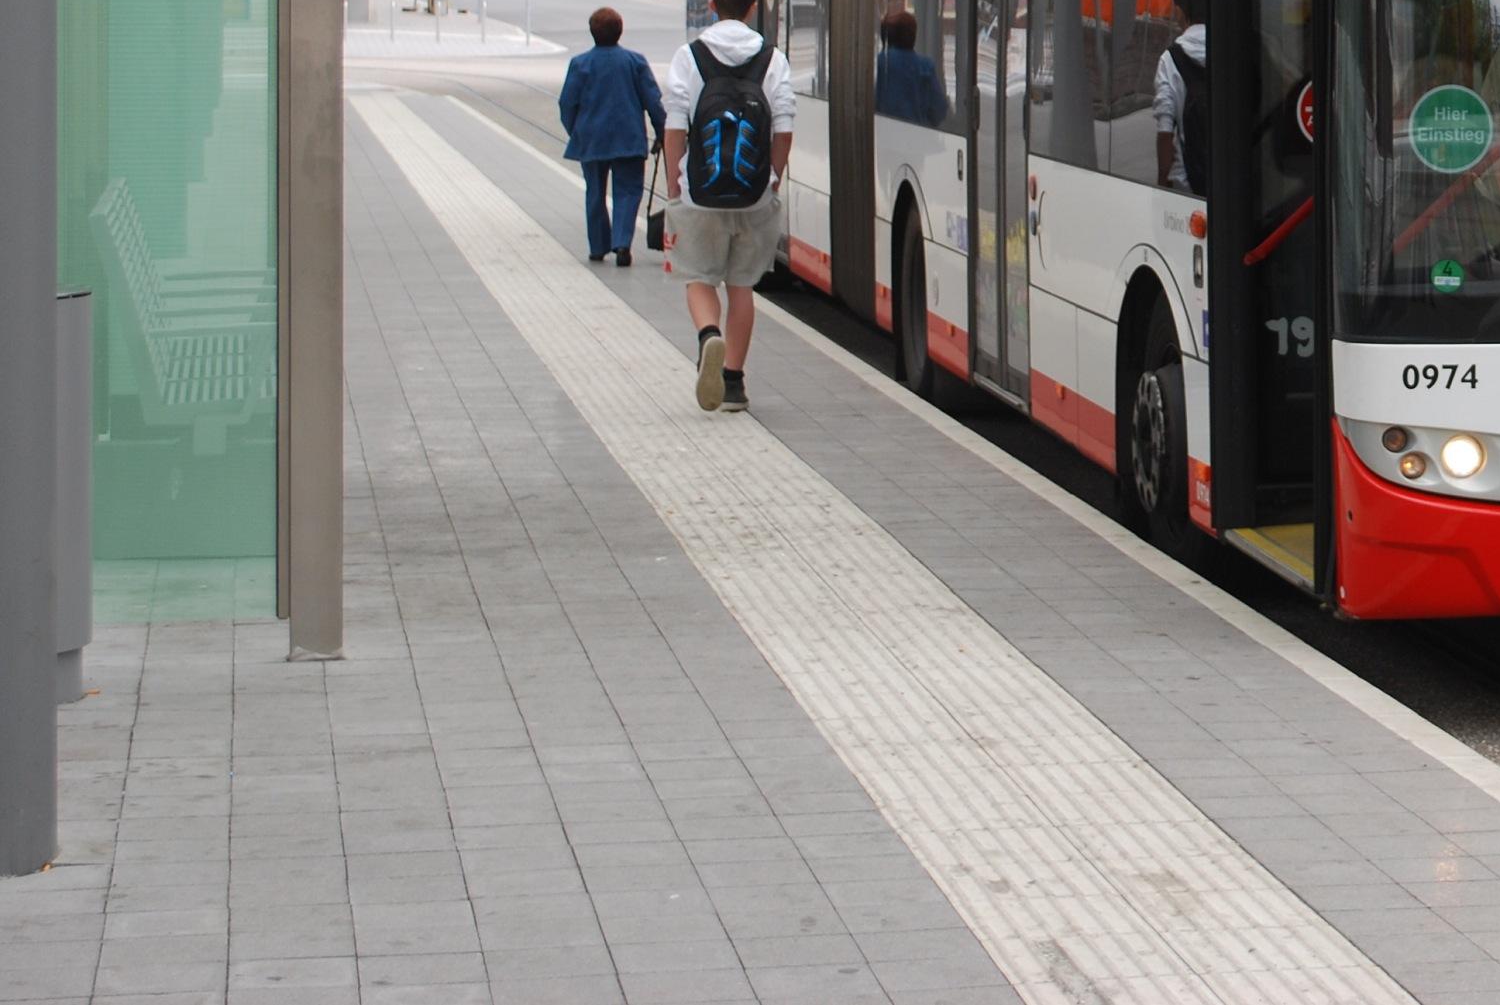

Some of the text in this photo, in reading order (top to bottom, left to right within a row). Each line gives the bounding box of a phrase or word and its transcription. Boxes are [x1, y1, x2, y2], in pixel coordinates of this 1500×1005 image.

[1434, 106, 1468, 121] Hier
[1417, 127, 1485, 145] Einstieg
[1443, 260, 1452, 276] 4
[1402, 363, 1478, 389] 0974
